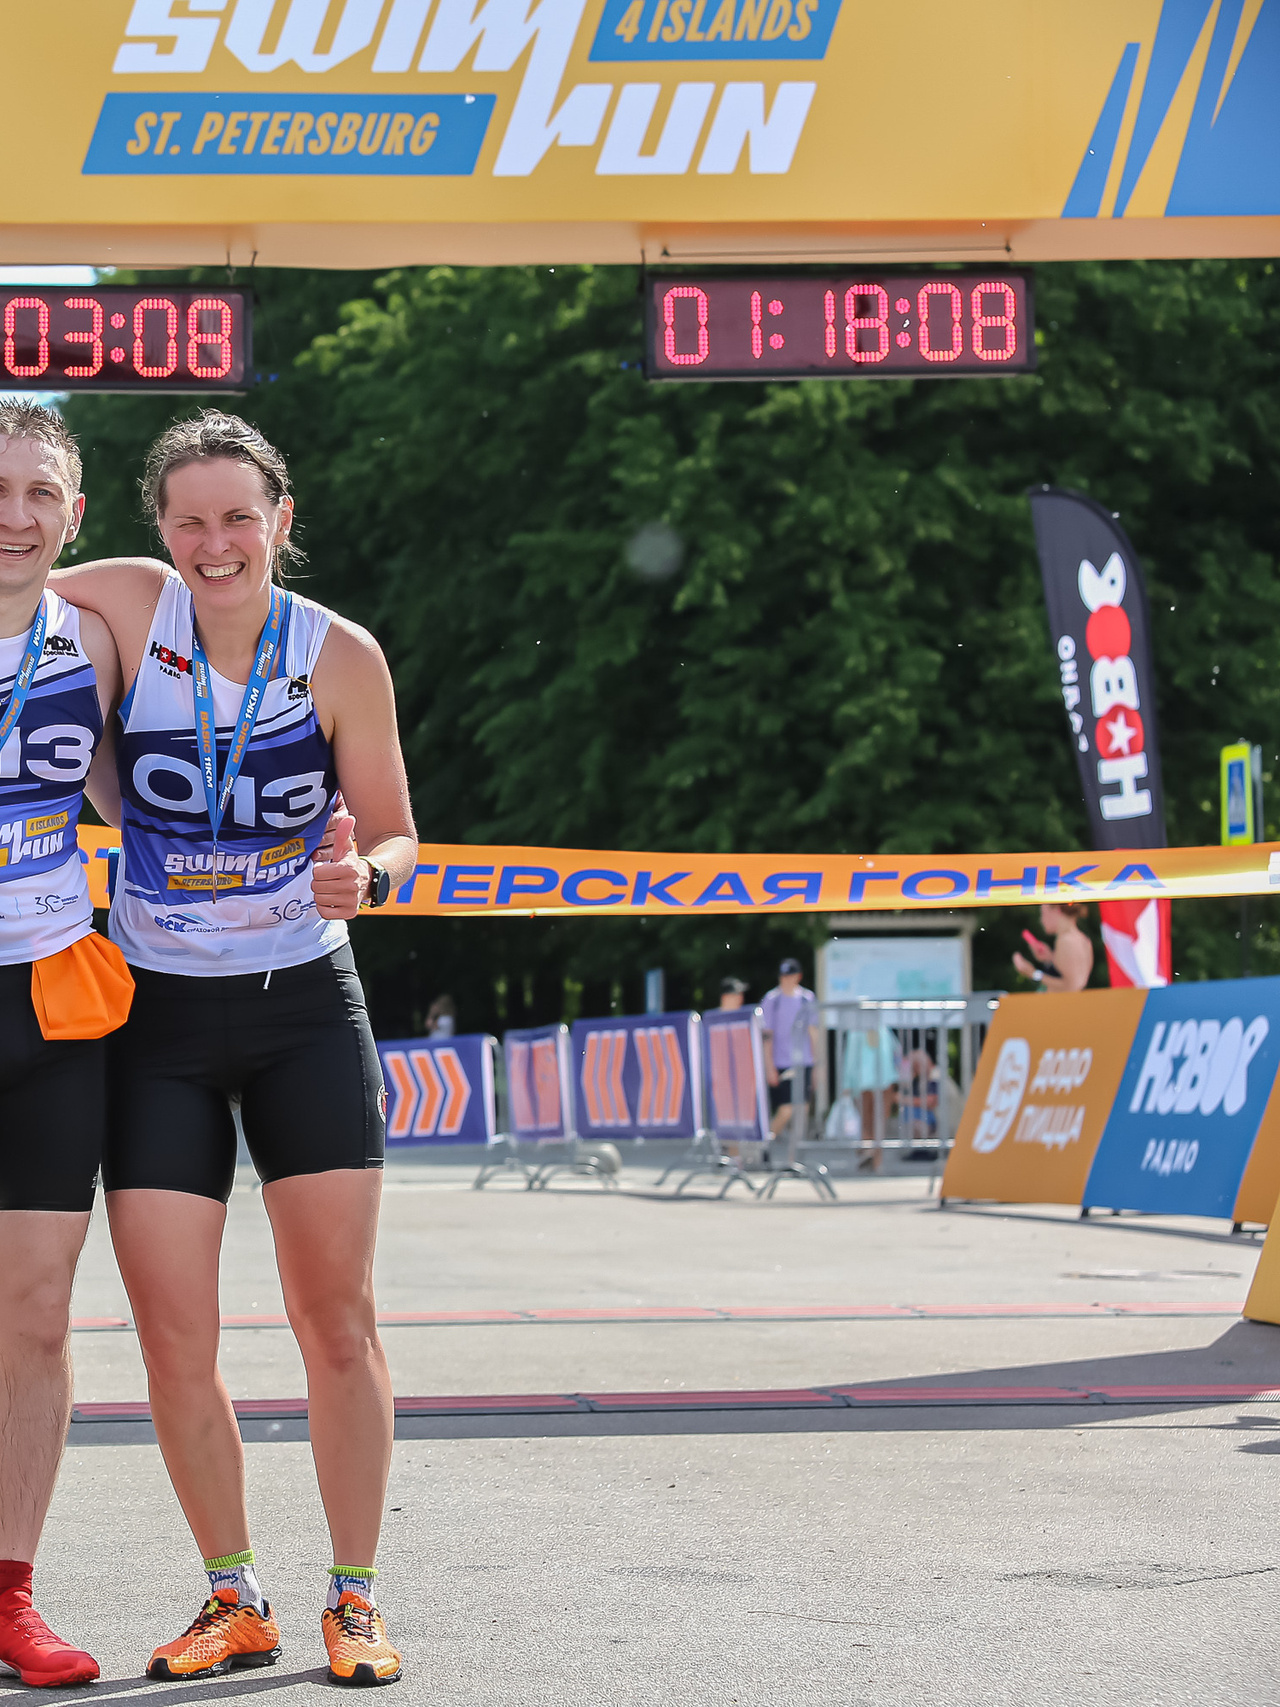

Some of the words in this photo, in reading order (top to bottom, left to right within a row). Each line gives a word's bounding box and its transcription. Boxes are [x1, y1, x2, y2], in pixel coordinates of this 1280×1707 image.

[614, 0, 645, 43] 4
[646, 0, 819, 42] ISLANDS
[126, 112, 182, 156] ST.
[192, 111, 440, 156] PETERSBURG
[663, 281, 1017, 366] 01:18:08
[0, 698, 20, 737] BASIC
[200, 710, 211, 754] BASIC
[232, 720, 251, 764] BASIC
[244, 686, 260, 720] 11KM
[204, 756, 214, 789] 11KM
[36, 814, 66, 831] ISLANDS
[395, 863, 824, 907] ТЕРСКАЯ
[848, 863, 1168, 903] ГОНКА
[1140, 1138, 1200, 1177] РАДИО
